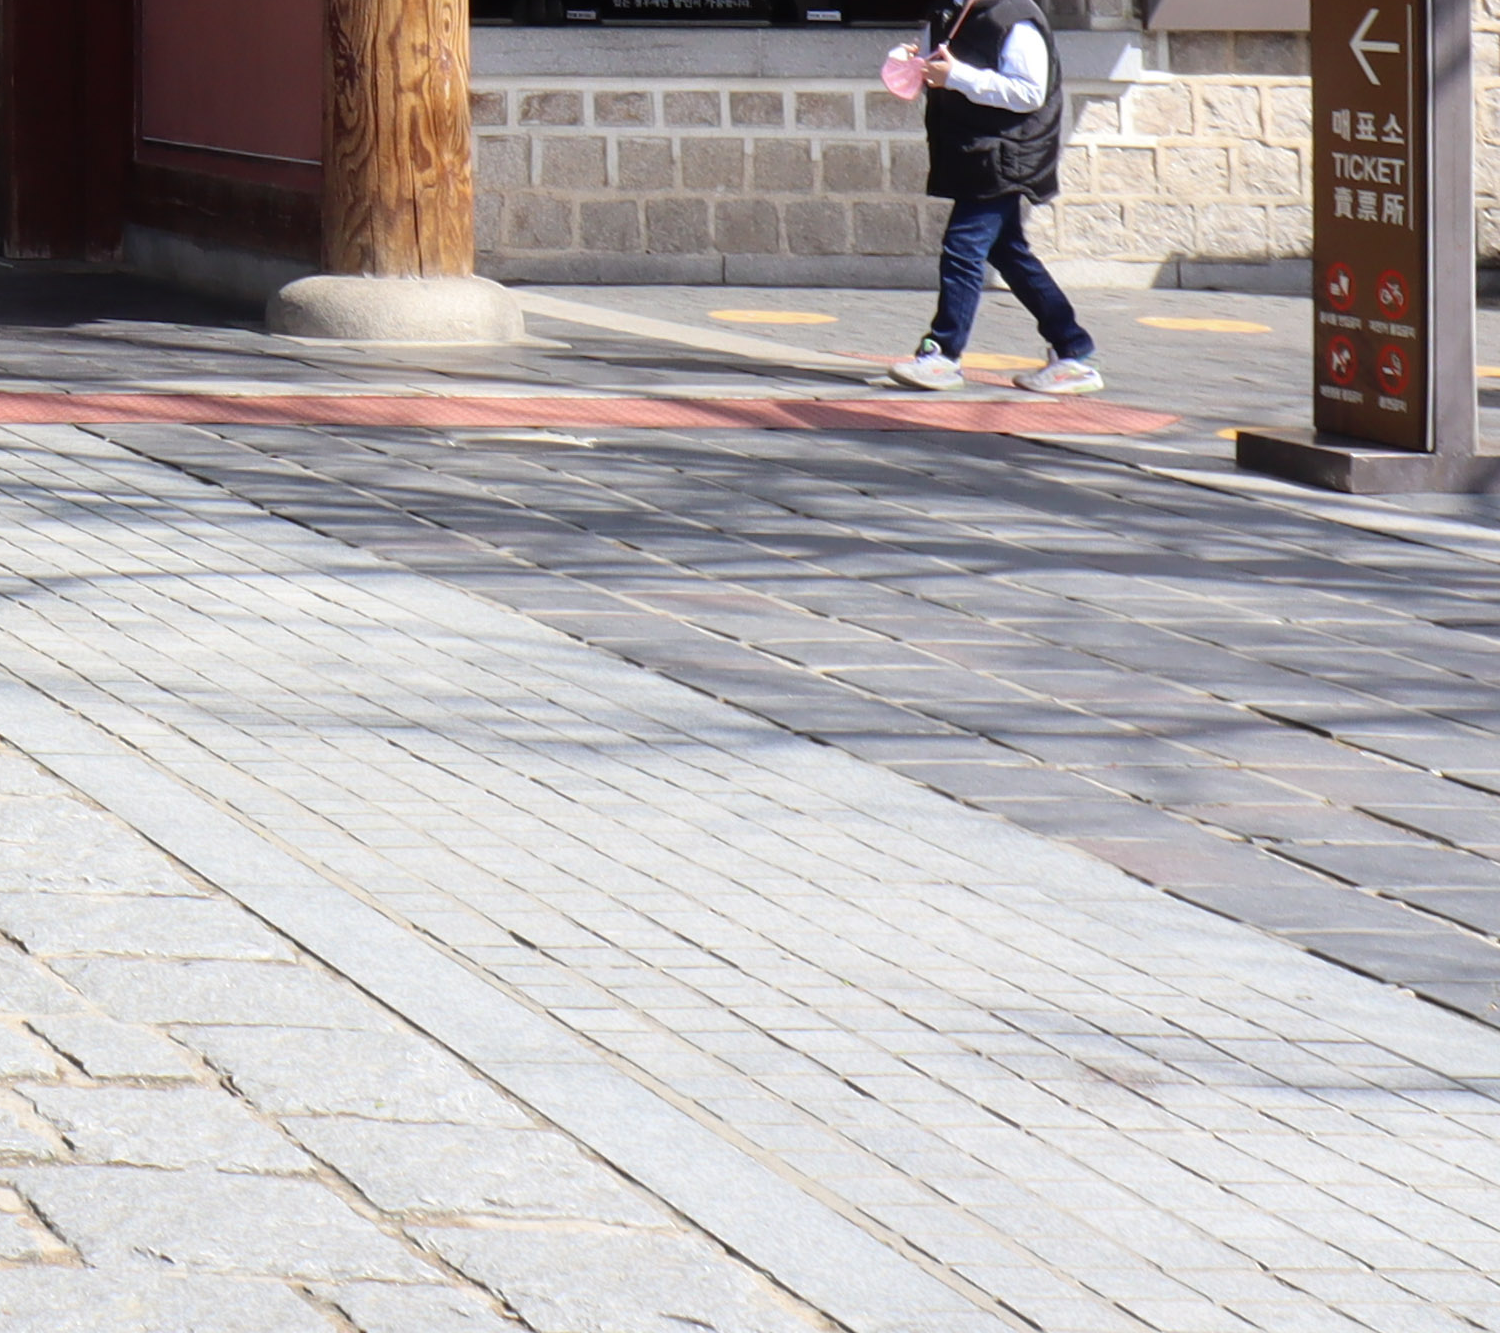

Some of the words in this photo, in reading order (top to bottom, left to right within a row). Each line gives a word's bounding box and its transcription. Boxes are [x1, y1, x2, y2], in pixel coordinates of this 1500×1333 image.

[1331, 109, 1405, 144] 매표소
[1331, 152, 1405, 185] TICKET
[1333, 187, 1405, 226] 賣票所
